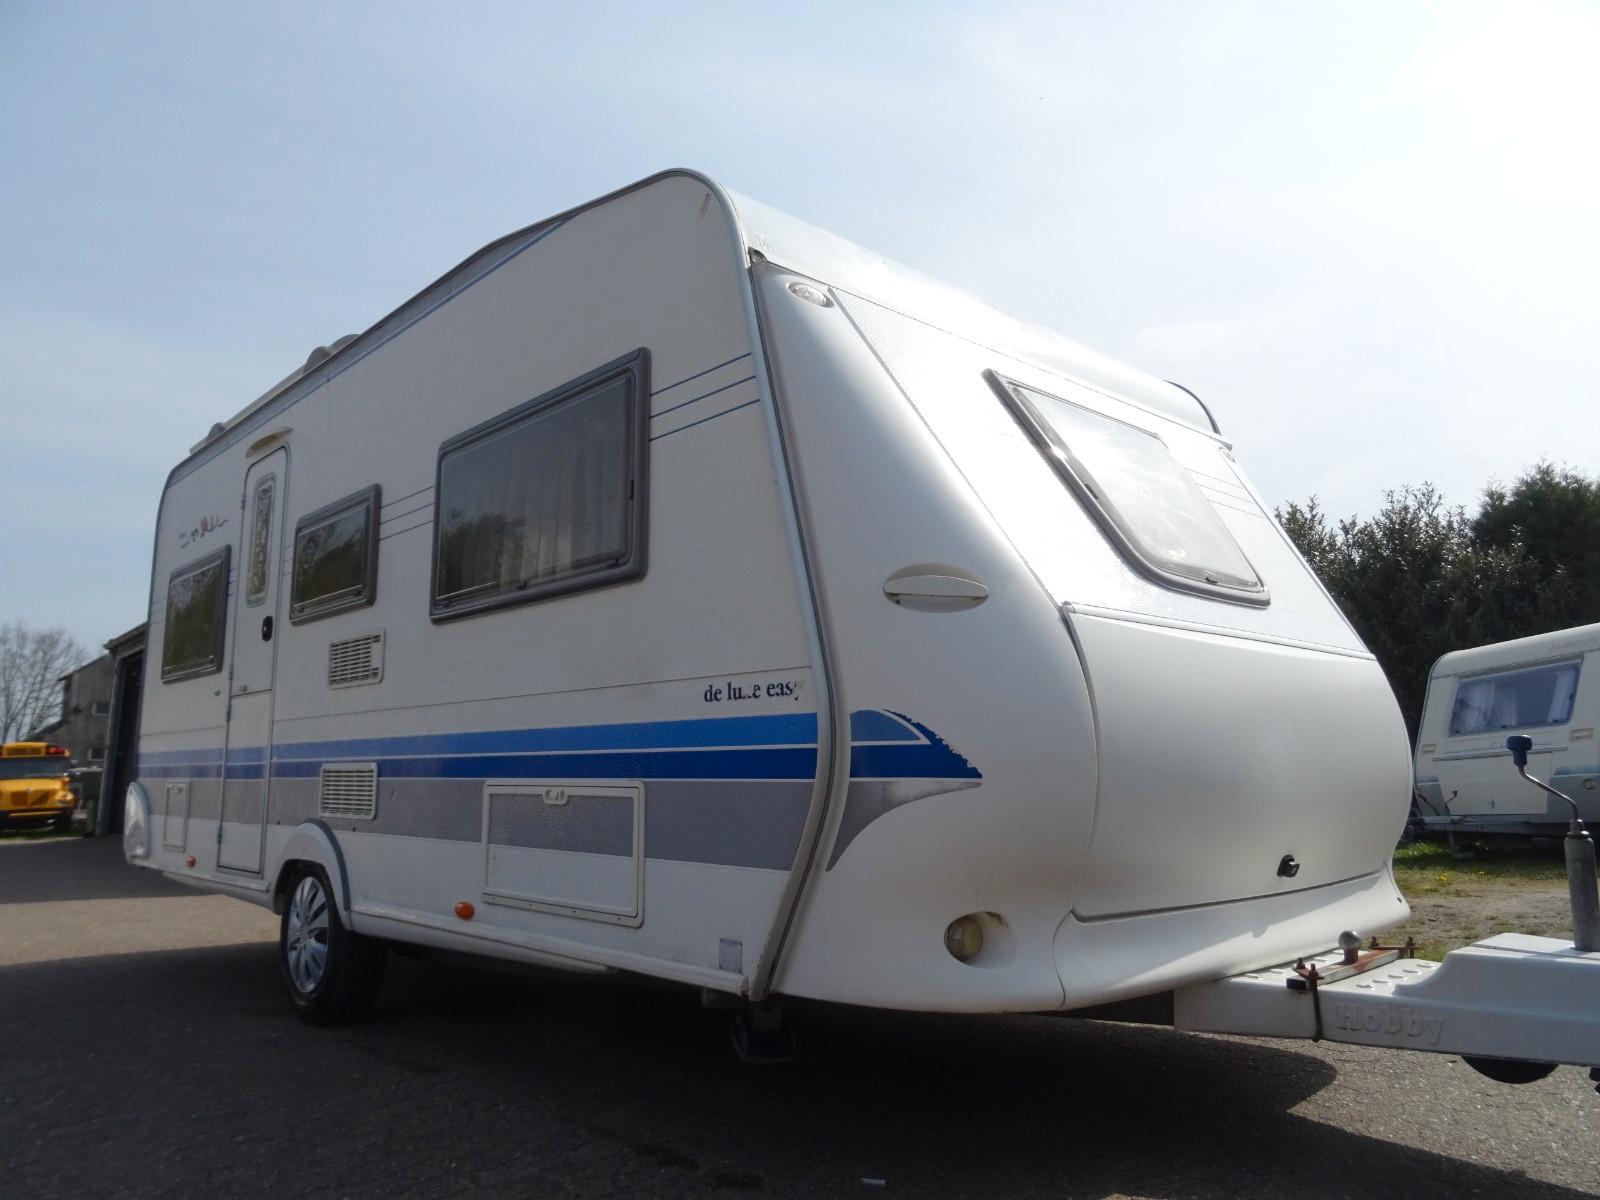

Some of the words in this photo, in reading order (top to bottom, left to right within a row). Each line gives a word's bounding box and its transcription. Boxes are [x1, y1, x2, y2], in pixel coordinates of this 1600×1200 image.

[704, 684, 722, 702] de
[727, 682, 761, 701] lue
[766, 680, 801, 701] eas
[1335, 1003, 1446, 1046] Hobby
